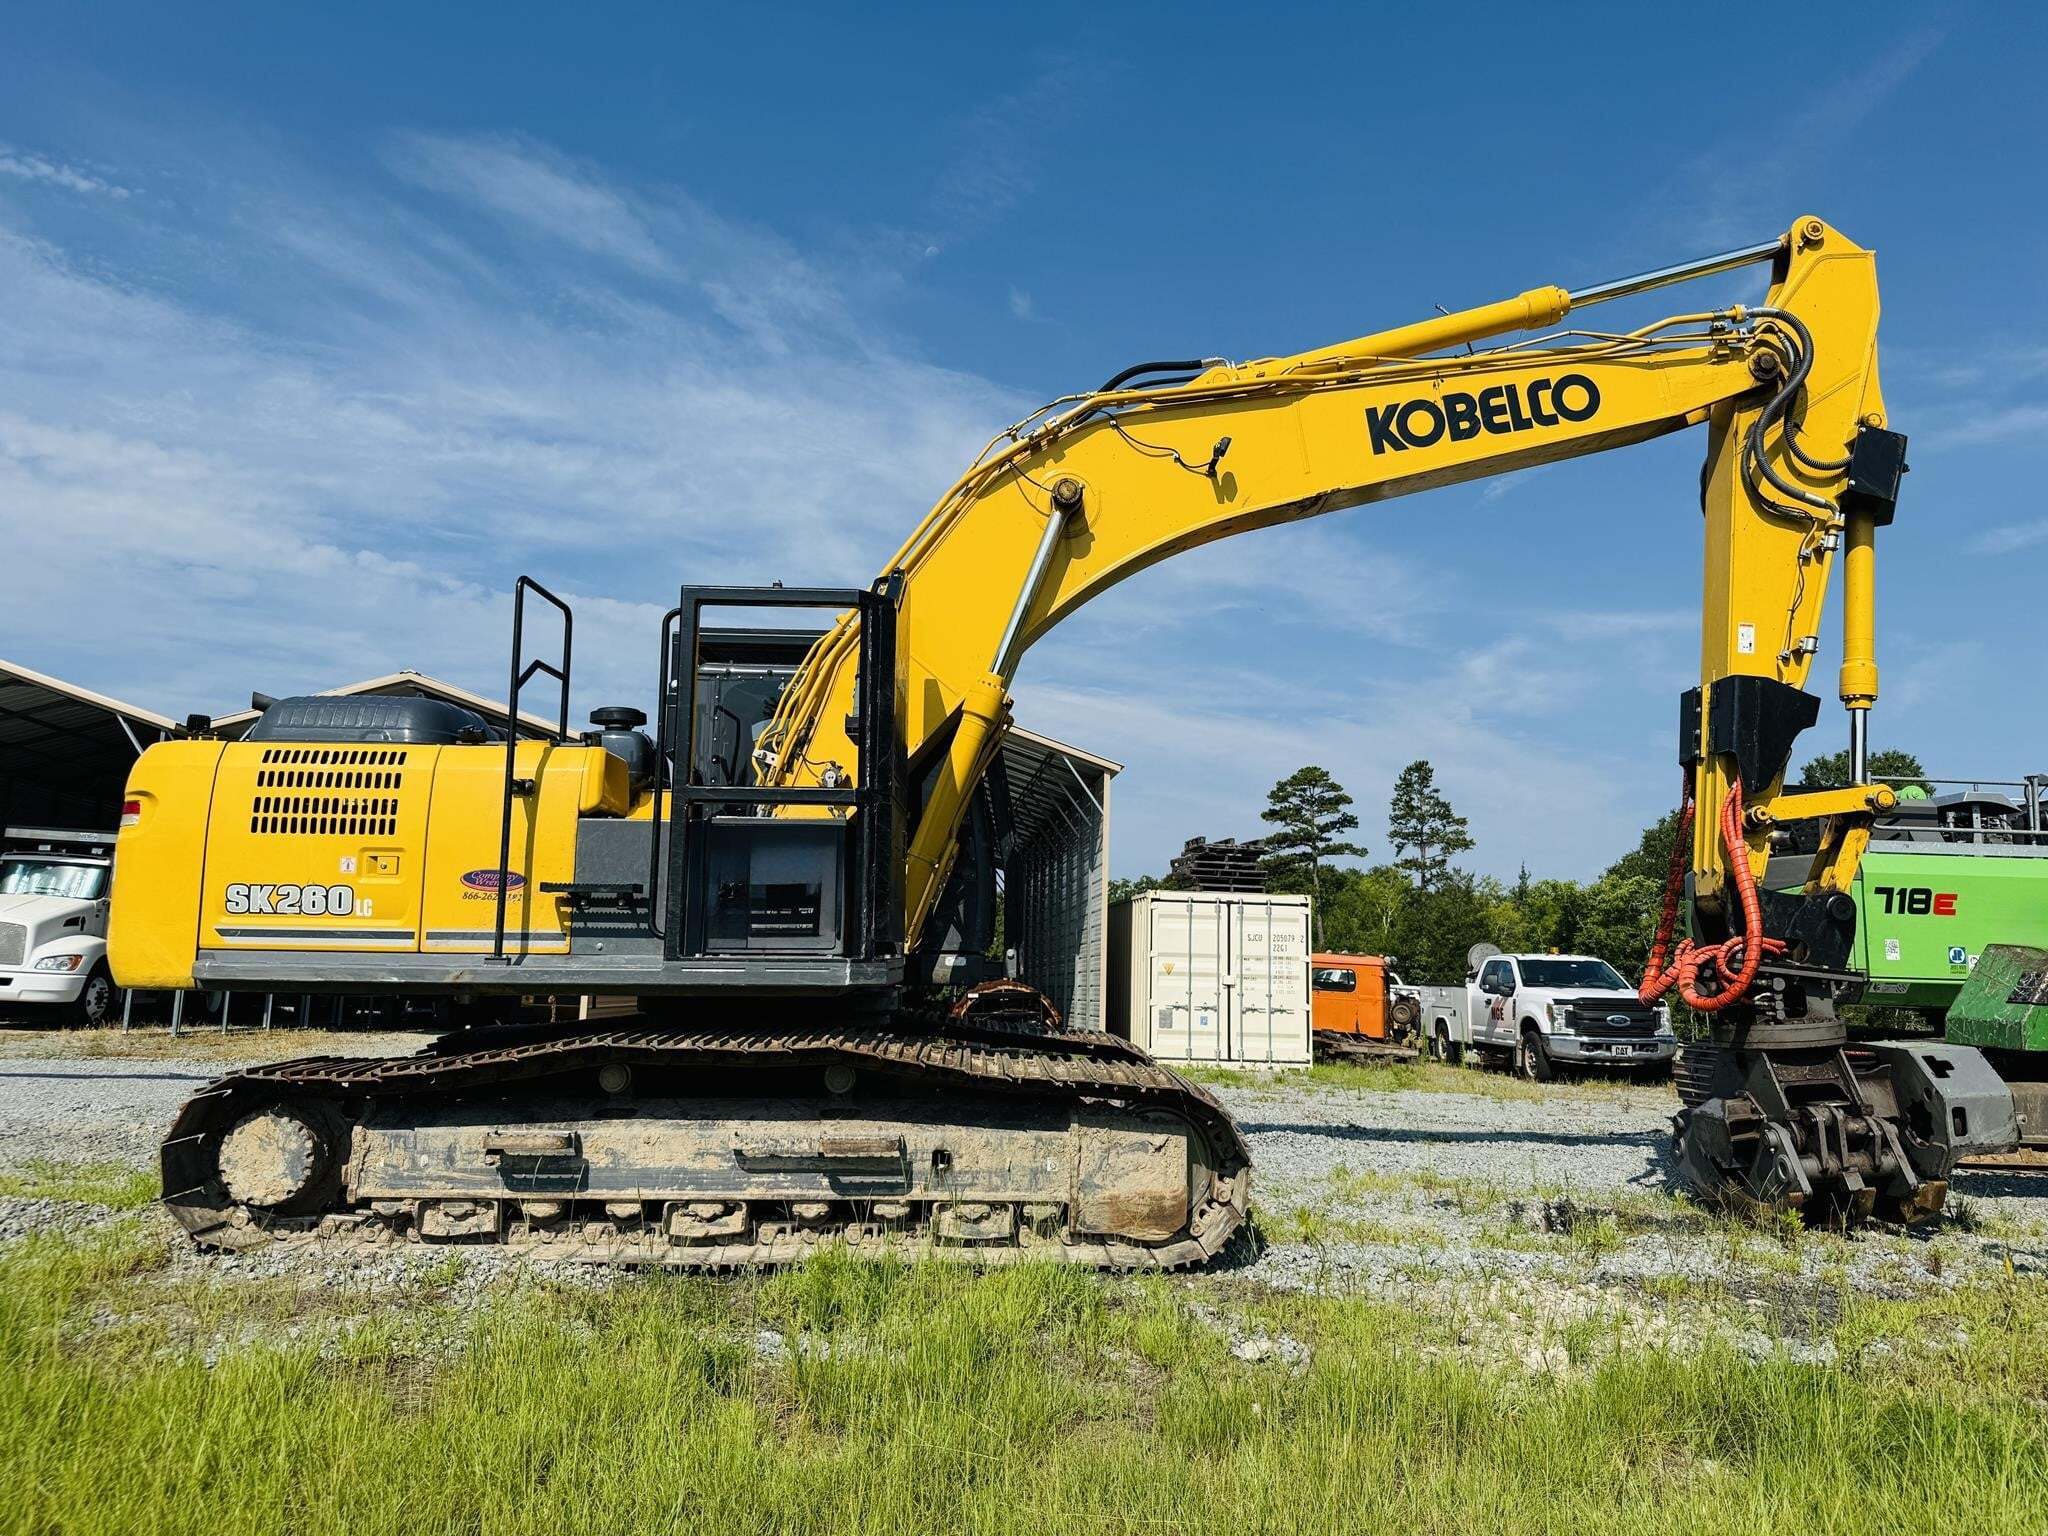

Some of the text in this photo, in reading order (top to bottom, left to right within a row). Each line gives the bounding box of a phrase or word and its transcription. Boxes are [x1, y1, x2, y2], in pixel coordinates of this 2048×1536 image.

[1365, 374, 1600, 455] KOBELCO
[471, 871, 518, 881] Compny
[226, 883, 373, 917] SK260 LC
[1874, 886, 1958, 916] 718E
[1247, 934, 1263, 942] SJCU
[1272, 934, 1295, 943] 205079
